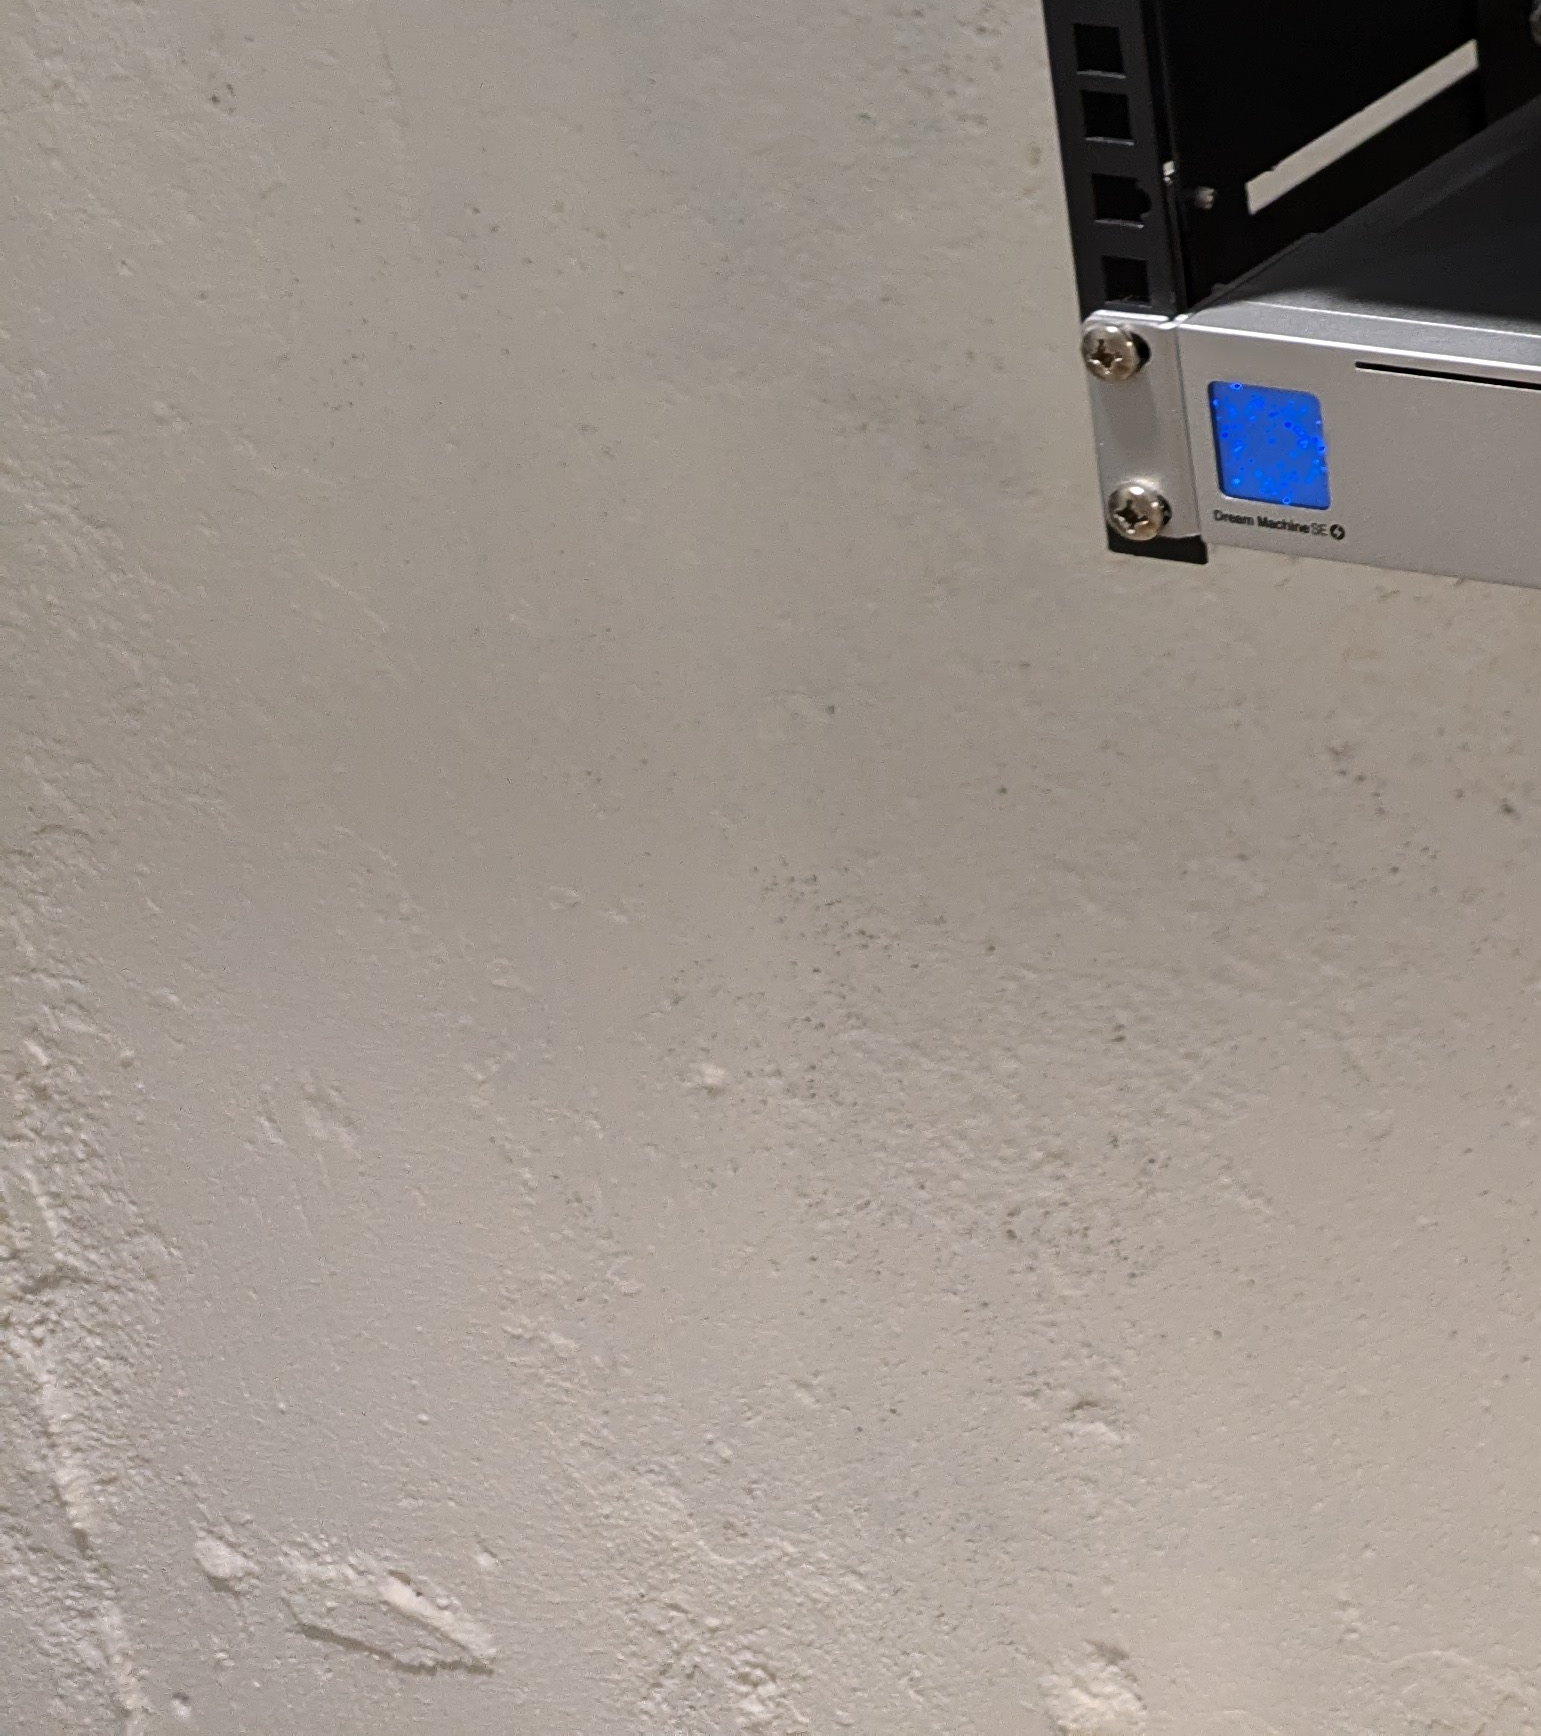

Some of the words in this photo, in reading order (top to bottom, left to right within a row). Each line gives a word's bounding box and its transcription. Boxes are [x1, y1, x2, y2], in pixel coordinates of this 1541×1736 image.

[1213, 509, 1255, 526] Dream
[1257, 515, 1310, 534] Machine
[1311, 522, 1328, 536] SE
